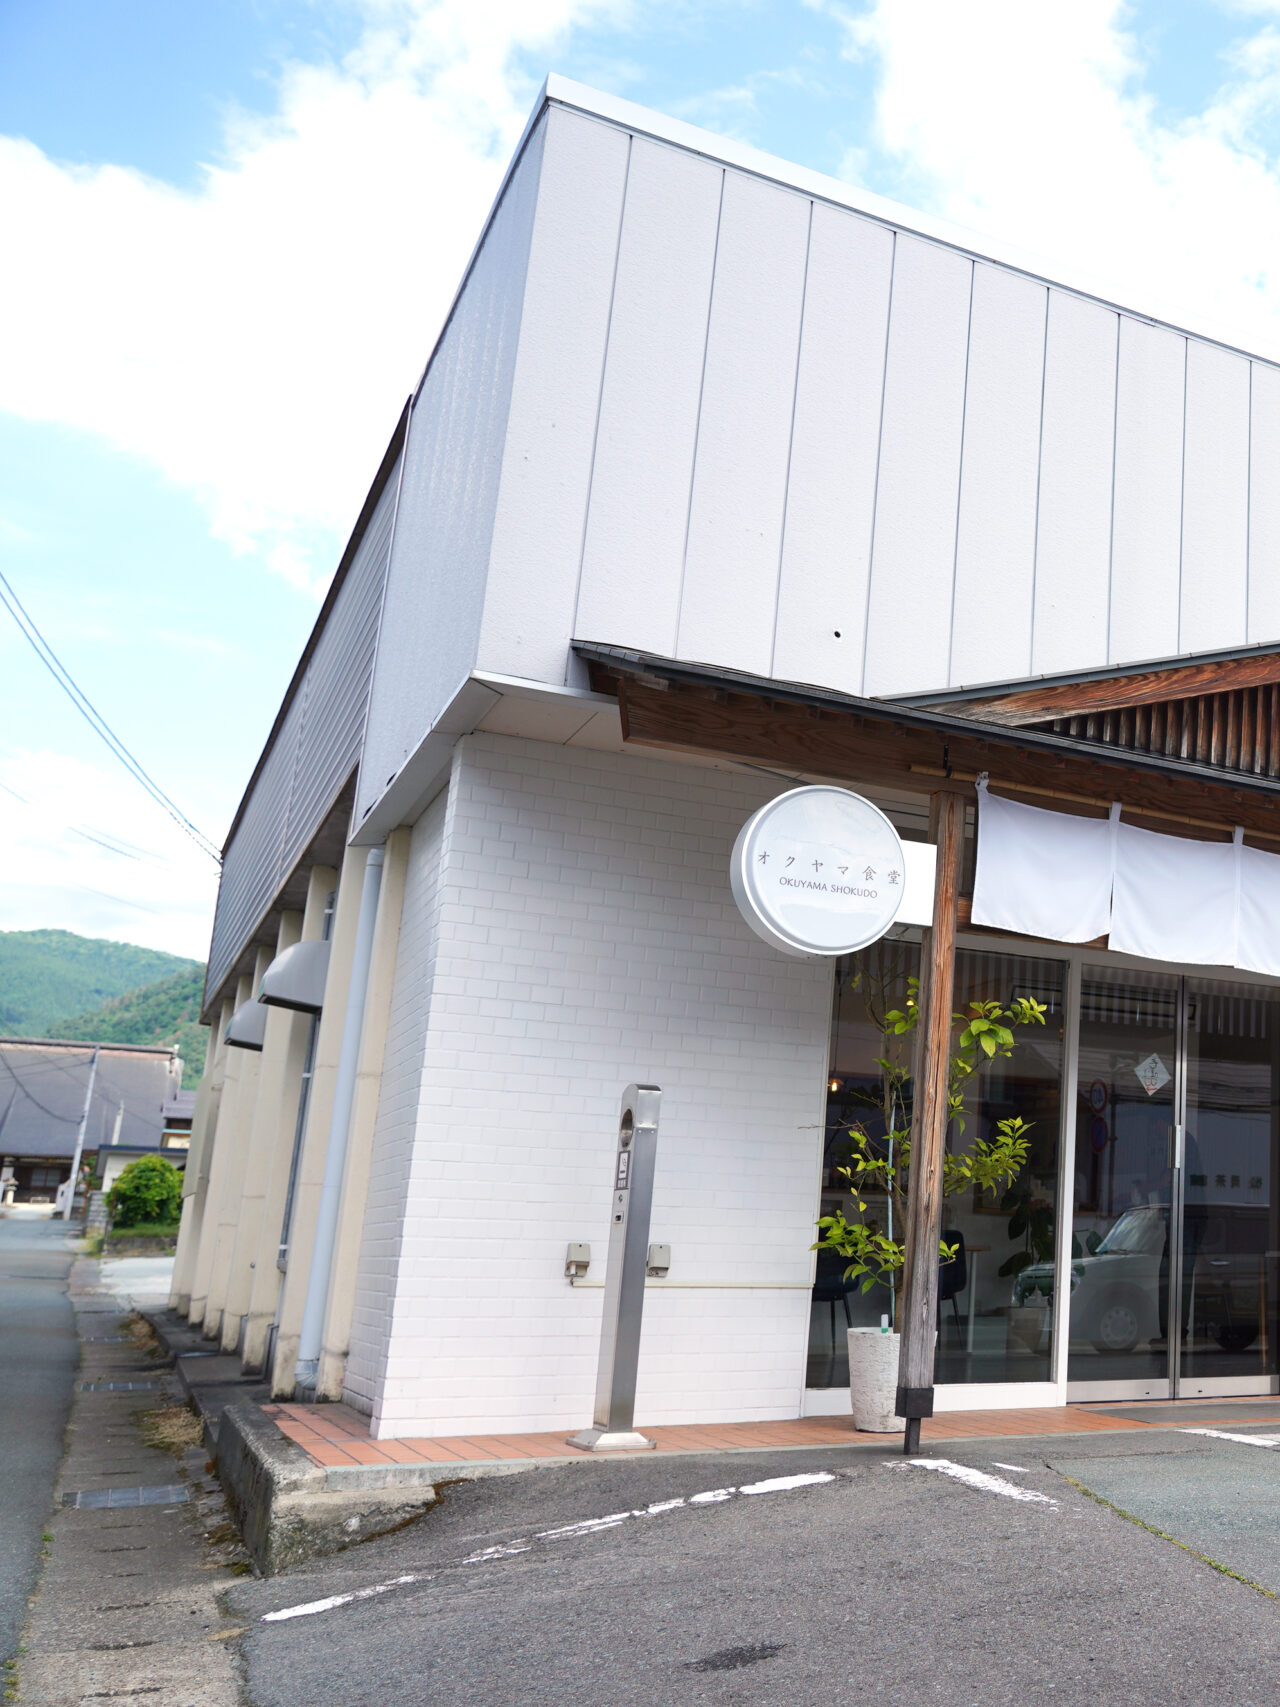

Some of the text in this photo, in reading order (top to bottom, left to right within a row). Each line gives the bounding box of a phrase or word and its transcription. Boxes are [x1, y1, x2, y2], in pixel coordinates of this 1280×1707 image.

[758, 851, 901, 885] オクヤマ食堂
[779, 876, 878, 898] OKUYAMA SHOKUDO
